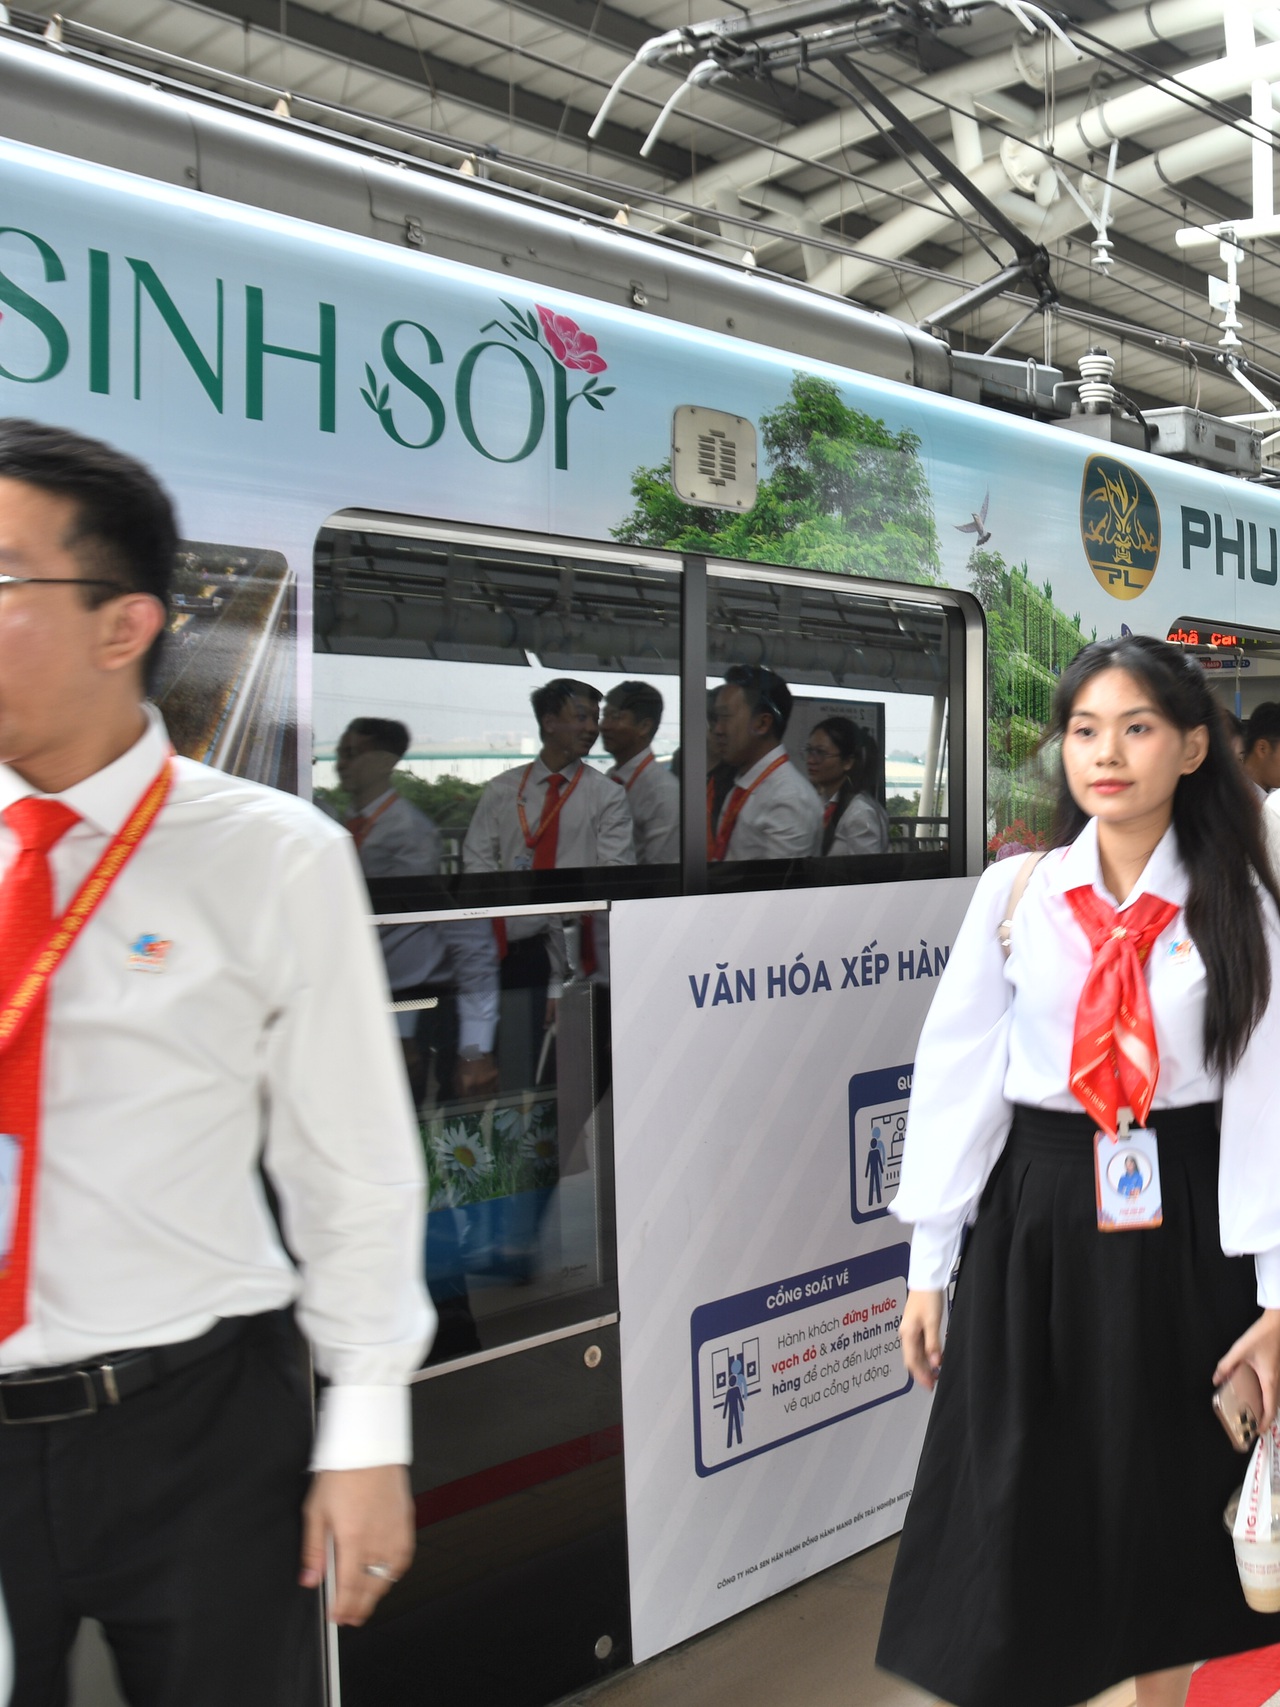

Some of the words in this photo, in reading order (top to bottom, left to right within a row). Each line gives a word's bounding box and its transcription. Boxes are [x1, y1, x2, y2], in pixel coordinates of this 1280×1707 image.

[0, 226, 337, 435] SINH
[1104, 567, 1145, 589] PL
[688, 962, 756, 1008] VĂN
[767, 952, 832, 999] HÓA
[841, 939, 890, 989] XẾP
[898, 939, 950, 981] HÀN
[766, 1285, 802, 1309] CỔNG
[805, 1275, 833, 1297] SOÁT
[836, 1268, 849, 1287] VÉ
[777, 1329, 805, 1349] Hành
[808, 1317, 840, 1338] khách
[842, 1309, 868, 1327] đứng
[871, 1298, 897, 1316] trước
[771, 1355, 799, 1374] vạch
[802, 1345, 817, 1363] đỏ
[820, 1343, 827, 1356] &
[830, 1333, 850, 1352] xếp
[853, 1324, 881, 1344] thành
[772, 1376, 801, 1396] hàng
[803, 1364, 818, 1384] để
[820, 1361, 840, 1378] chờ
[842, 1350, 862, 1369] đến
[864, 1344, 881, 1361] lượt
[784, 1398, 797, 1413] vé
[800, 1390, 821, 1408] qua
[823, 1378, 850, 1399] cổng
[852, 1373, 862, 1388] tự
[864, 1364, 892, 1382] động.
